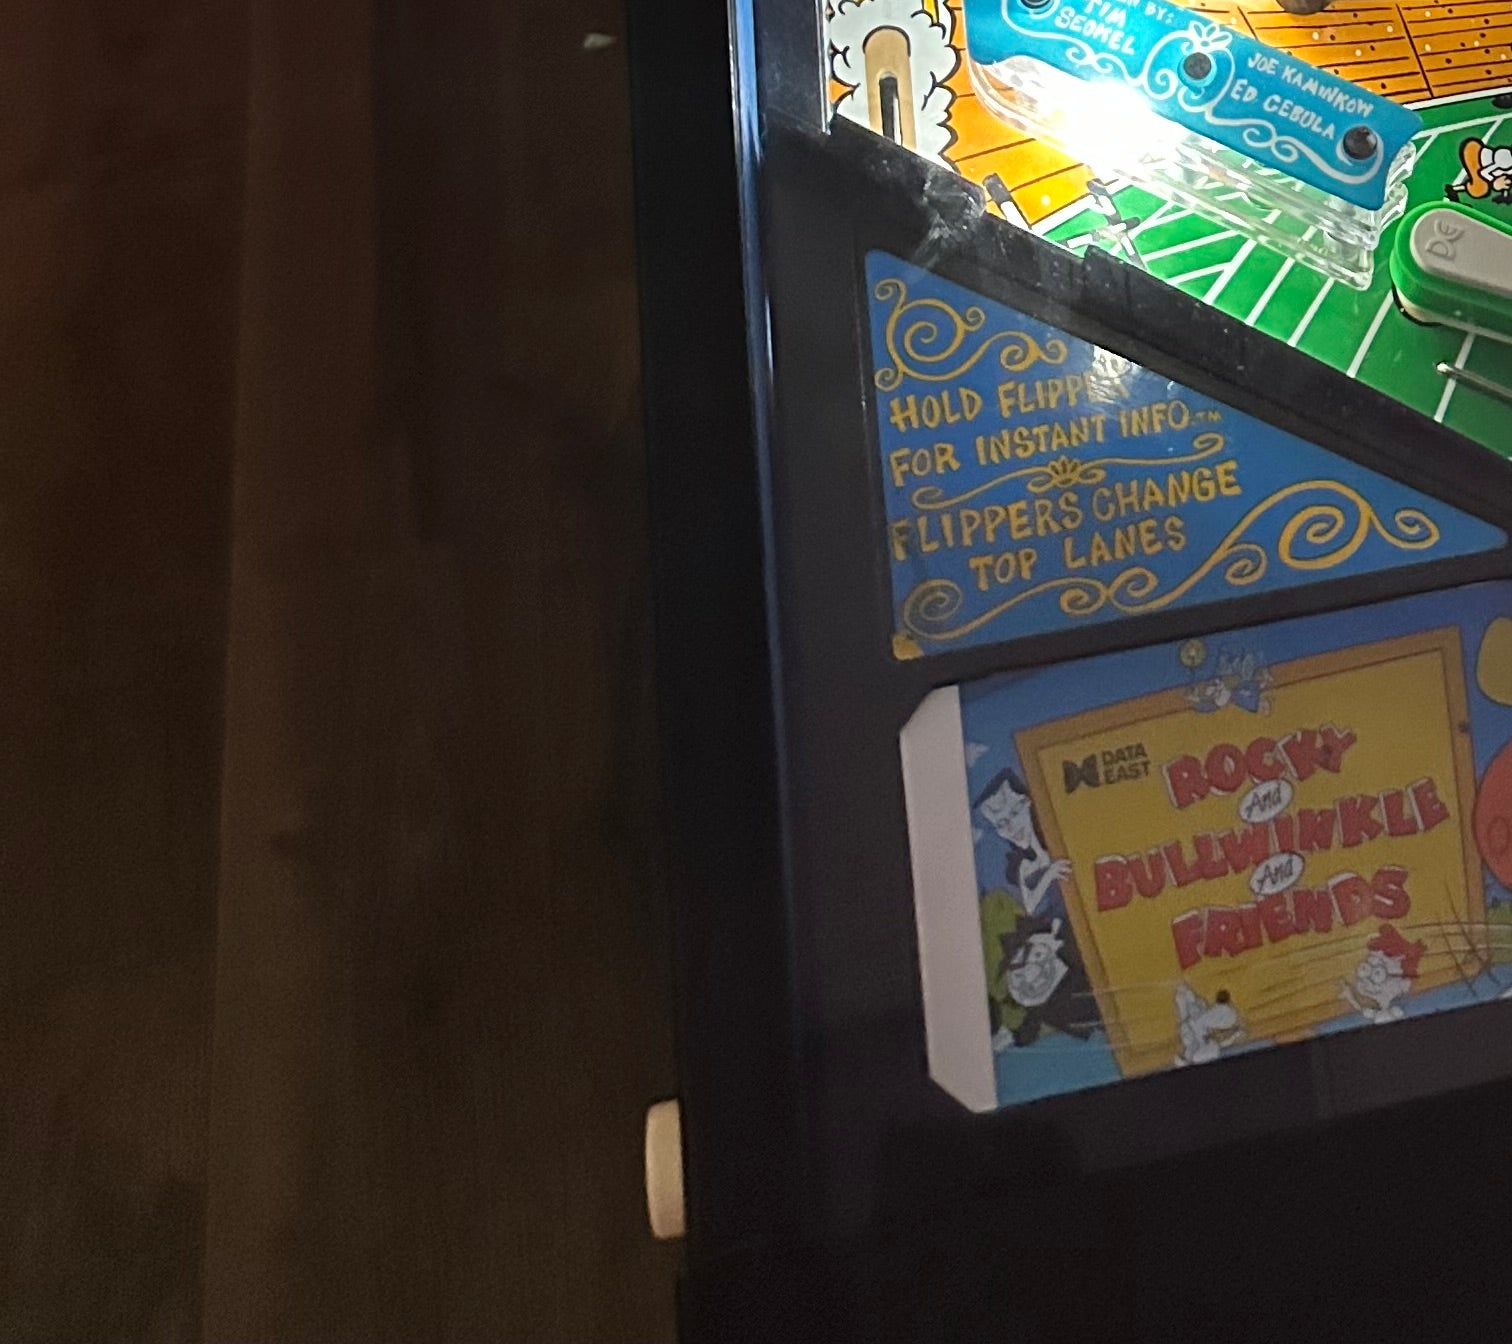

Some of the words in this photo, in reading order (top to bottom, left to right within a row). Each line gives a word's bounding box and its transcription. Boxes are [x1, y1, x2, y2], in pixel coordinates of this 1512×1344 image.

[1143, 0, 1176, 25] BY:
[1230, 78, 1258, 103] ED
[1261, 90, 1339, 141] CEBULA
[1246, 50, 1280, 77] JOE
[1280, 62, 1375, 119] KAMINKOW
[889, 386, 983, 434] HOLD
[889, 441, 962, 487] FOR
[974, 414, 1107, 466] INSTANT
[889, 490, 1083, 562] FLIPPERS
[1091, 459, 1244, 515] CHANGE
[967, 544, 1039, 594] TOP
[1061, 514, 1189, 573] LANES
[1101, 742, 1148, 766] DATA
[1103, 758, 1151, 783] EAST
[1162, 722, 1359, 812] ROCKY
[1241, 781, 1291, 818] And
[1093, 776, 1452, 913] BULLWINKLE
[1255, 855, 1300, 891] And
[1171, 864, 1413, 970] FRIENDS
